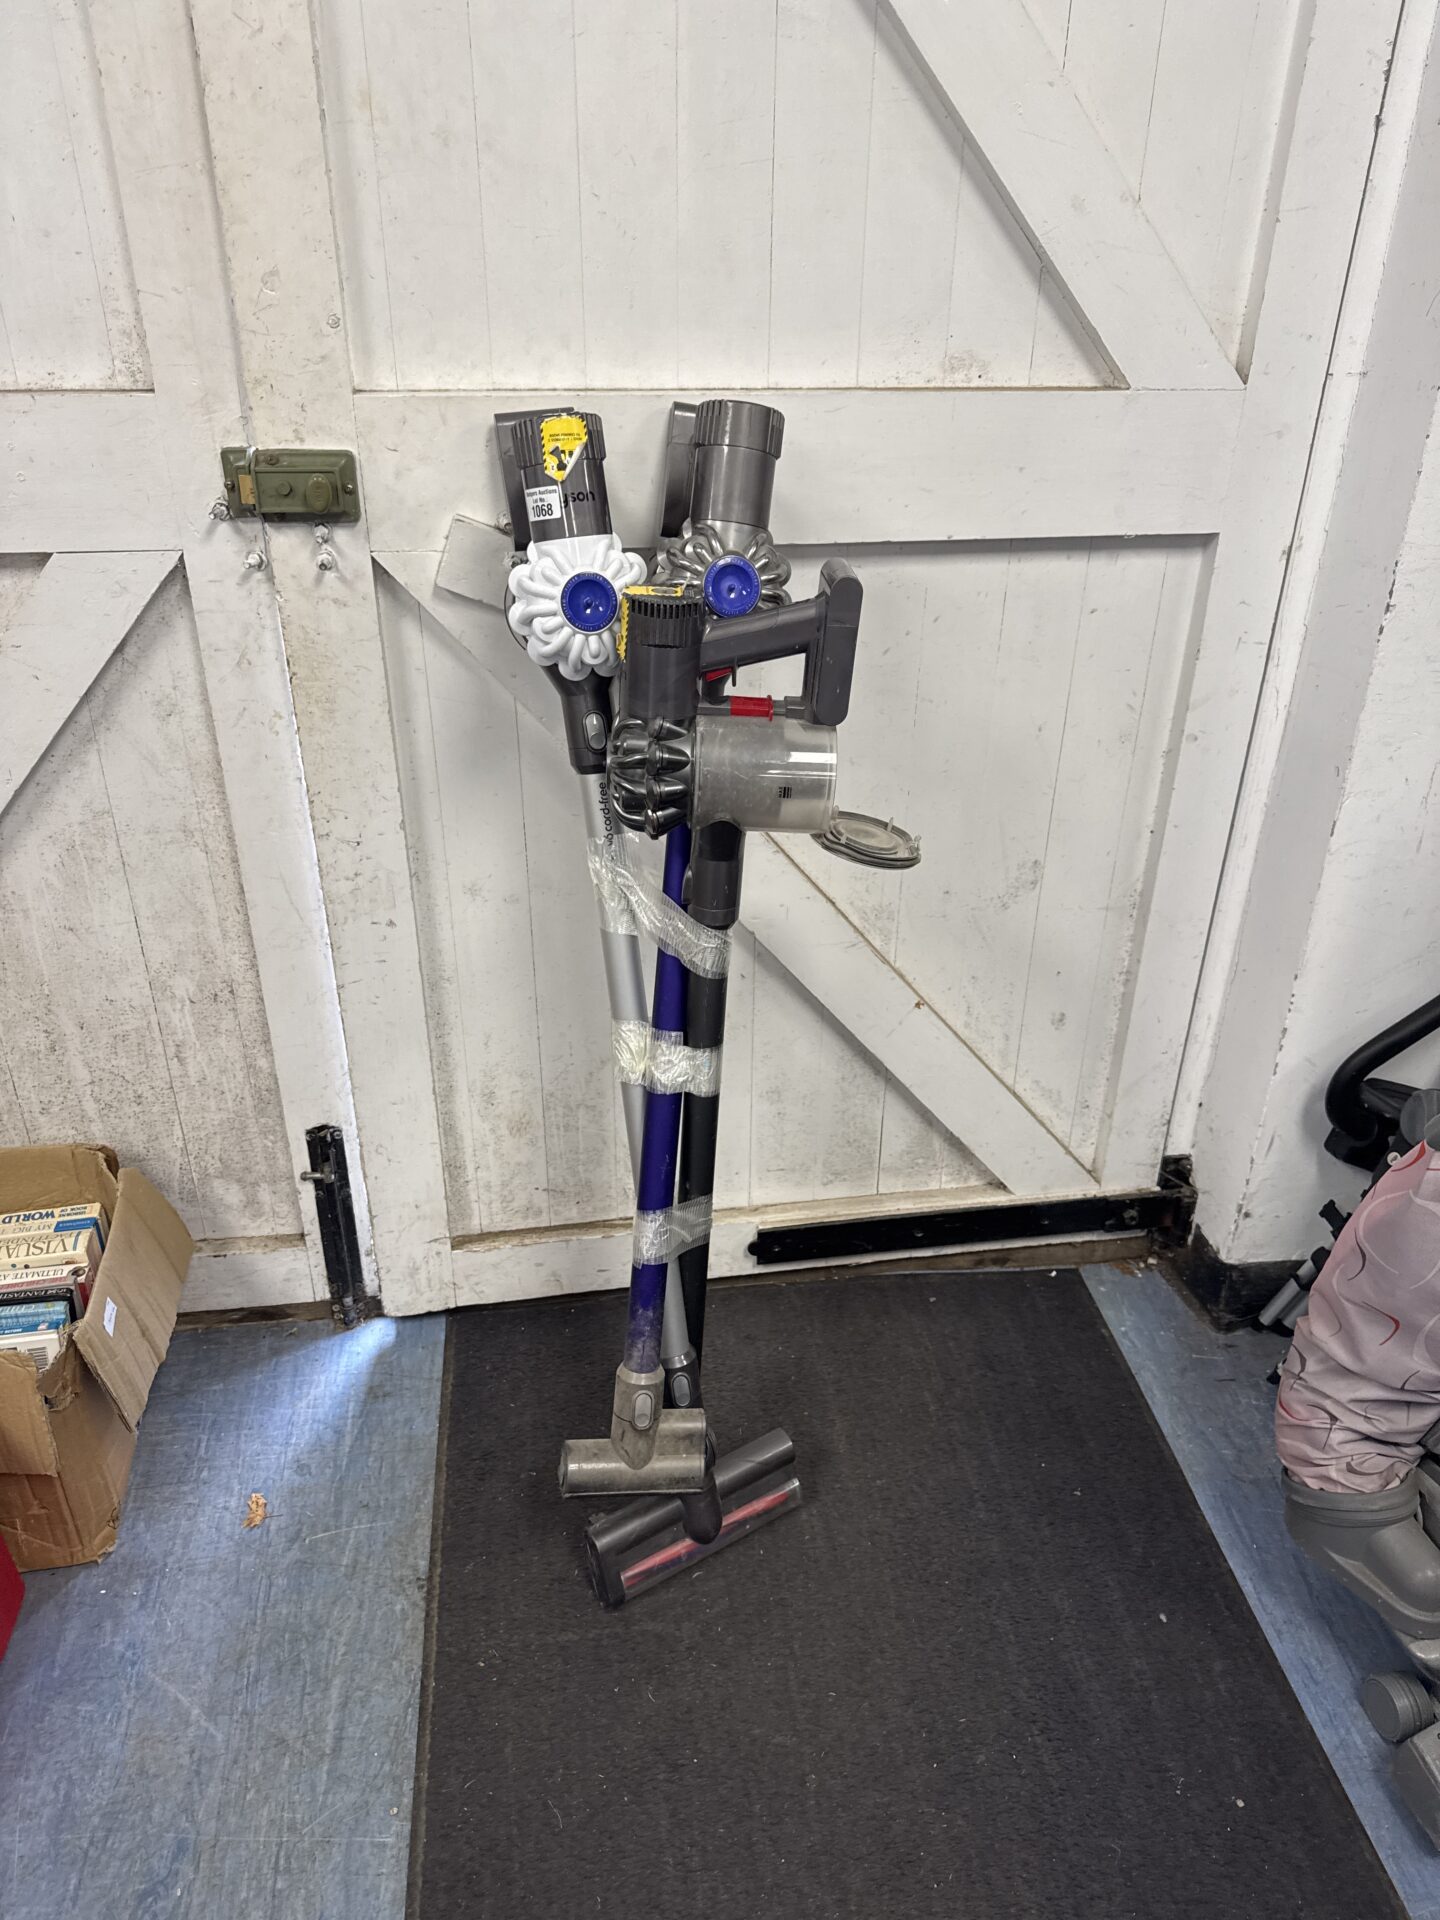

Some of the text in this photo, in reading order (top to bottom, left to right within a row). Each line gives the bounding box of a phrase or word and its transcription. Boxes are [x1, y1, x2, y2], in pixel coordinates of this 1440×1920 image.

[532, 502, 554, 518] 1068
[598, 782, 613, 832] cord-free
[2, 1209, 55, 1224] WORLD
[0, 1238, 68, 1259] VISUA
[11, 1268, 64, 1280] ULTIMATE
